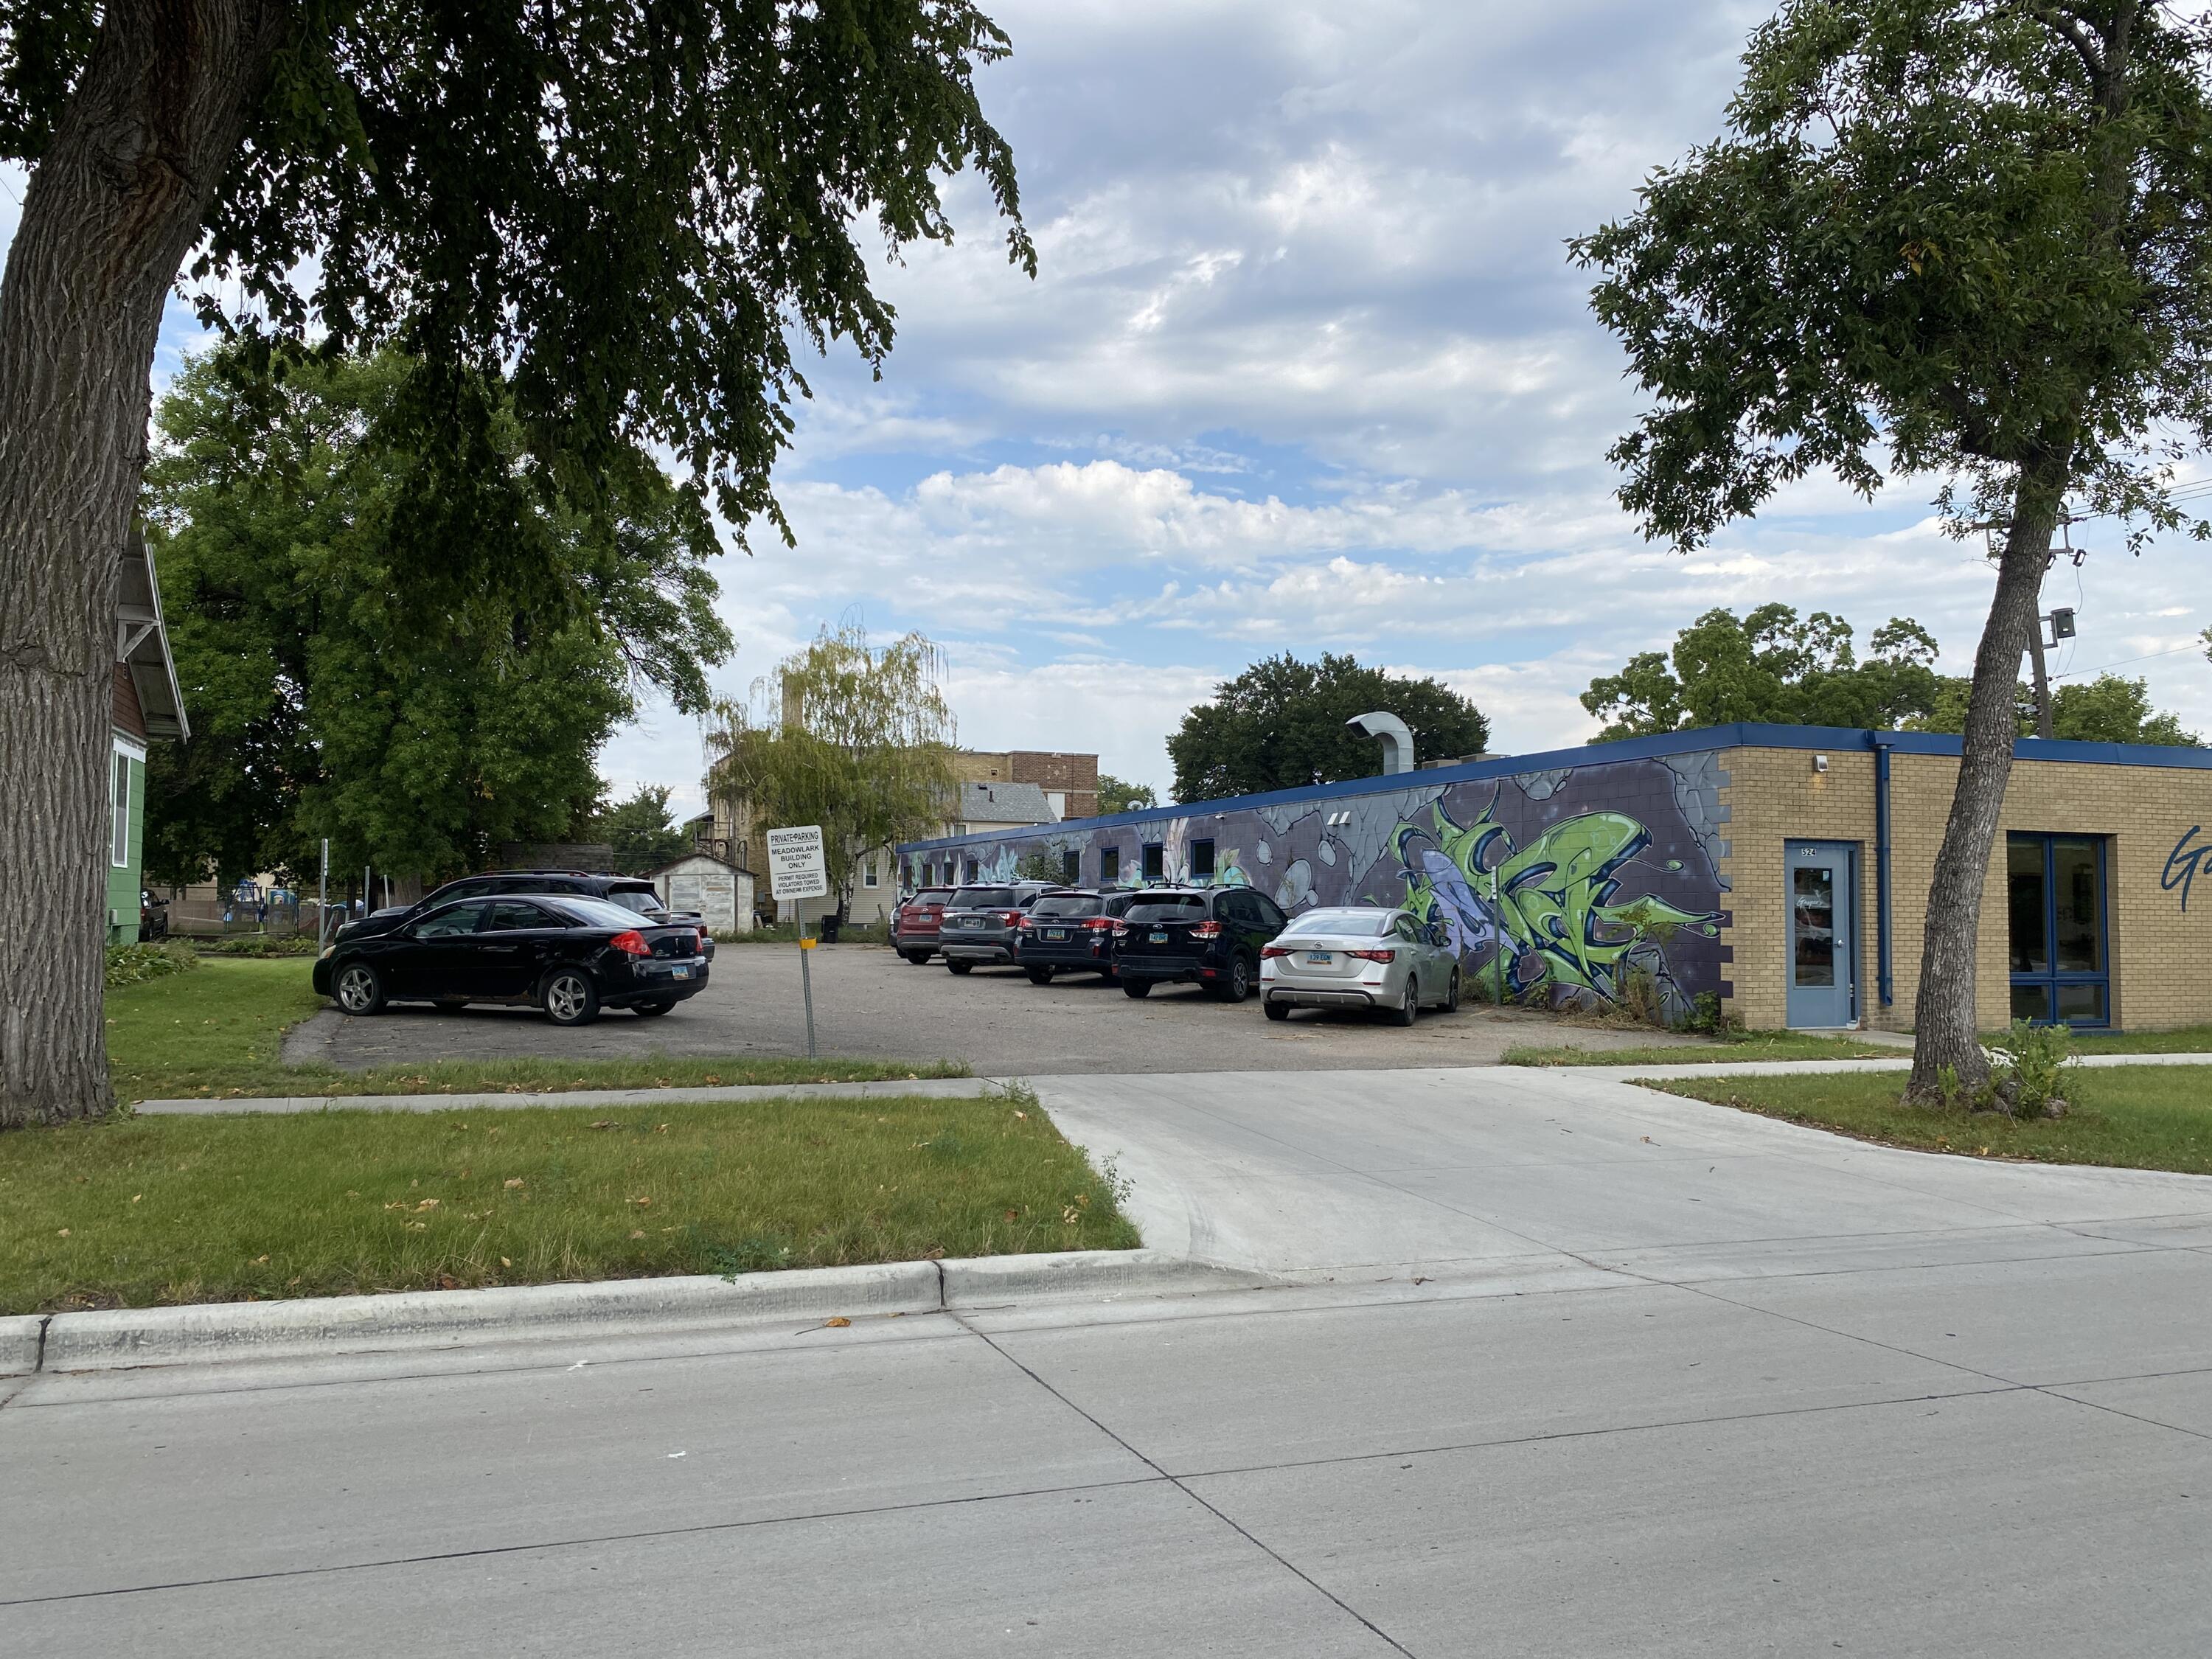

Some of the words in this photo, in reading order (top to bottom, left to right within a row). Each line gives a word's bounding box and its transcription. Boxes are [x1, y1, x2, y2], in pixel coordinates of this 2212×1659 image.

[771, 834, 793, 844] PRIVATE
[795, 831, 818, 841] PARKING
[771, 845, 819, 855] MEADOWLARK
[781, 853, 812, 861] BUILDING
